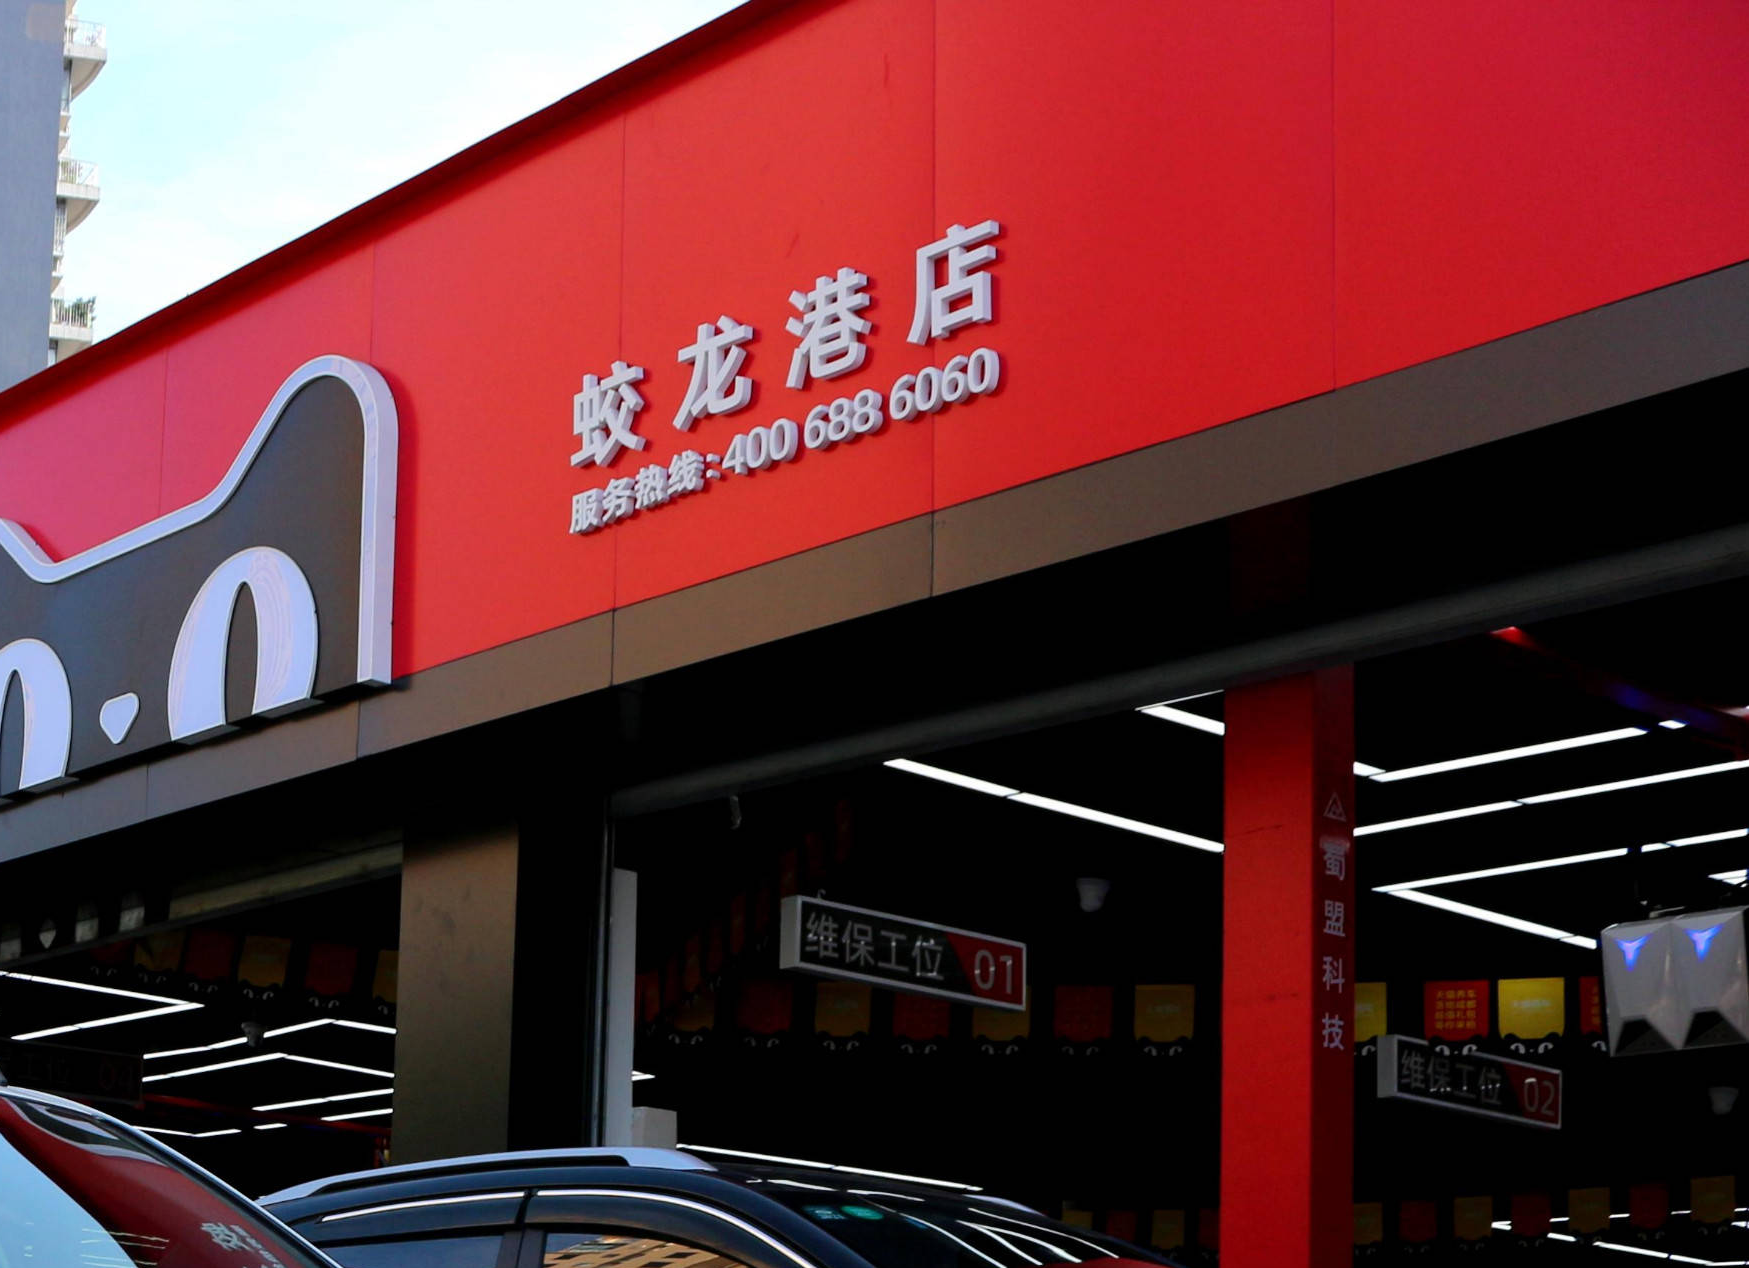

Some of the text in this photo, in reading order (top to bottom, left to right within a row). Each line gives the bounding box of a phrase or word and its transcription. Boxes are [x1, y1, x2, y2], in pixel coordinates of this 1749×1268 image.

[571, 220, 1000, 467] 蛟龙港店
[804, 388, 883, 450] 688
[888, 347, 1000, 422] 6060
[805, 911, 1013, 995] 维保工位 01
[1400, 1050, 1556, 1117] 维保工位 02
